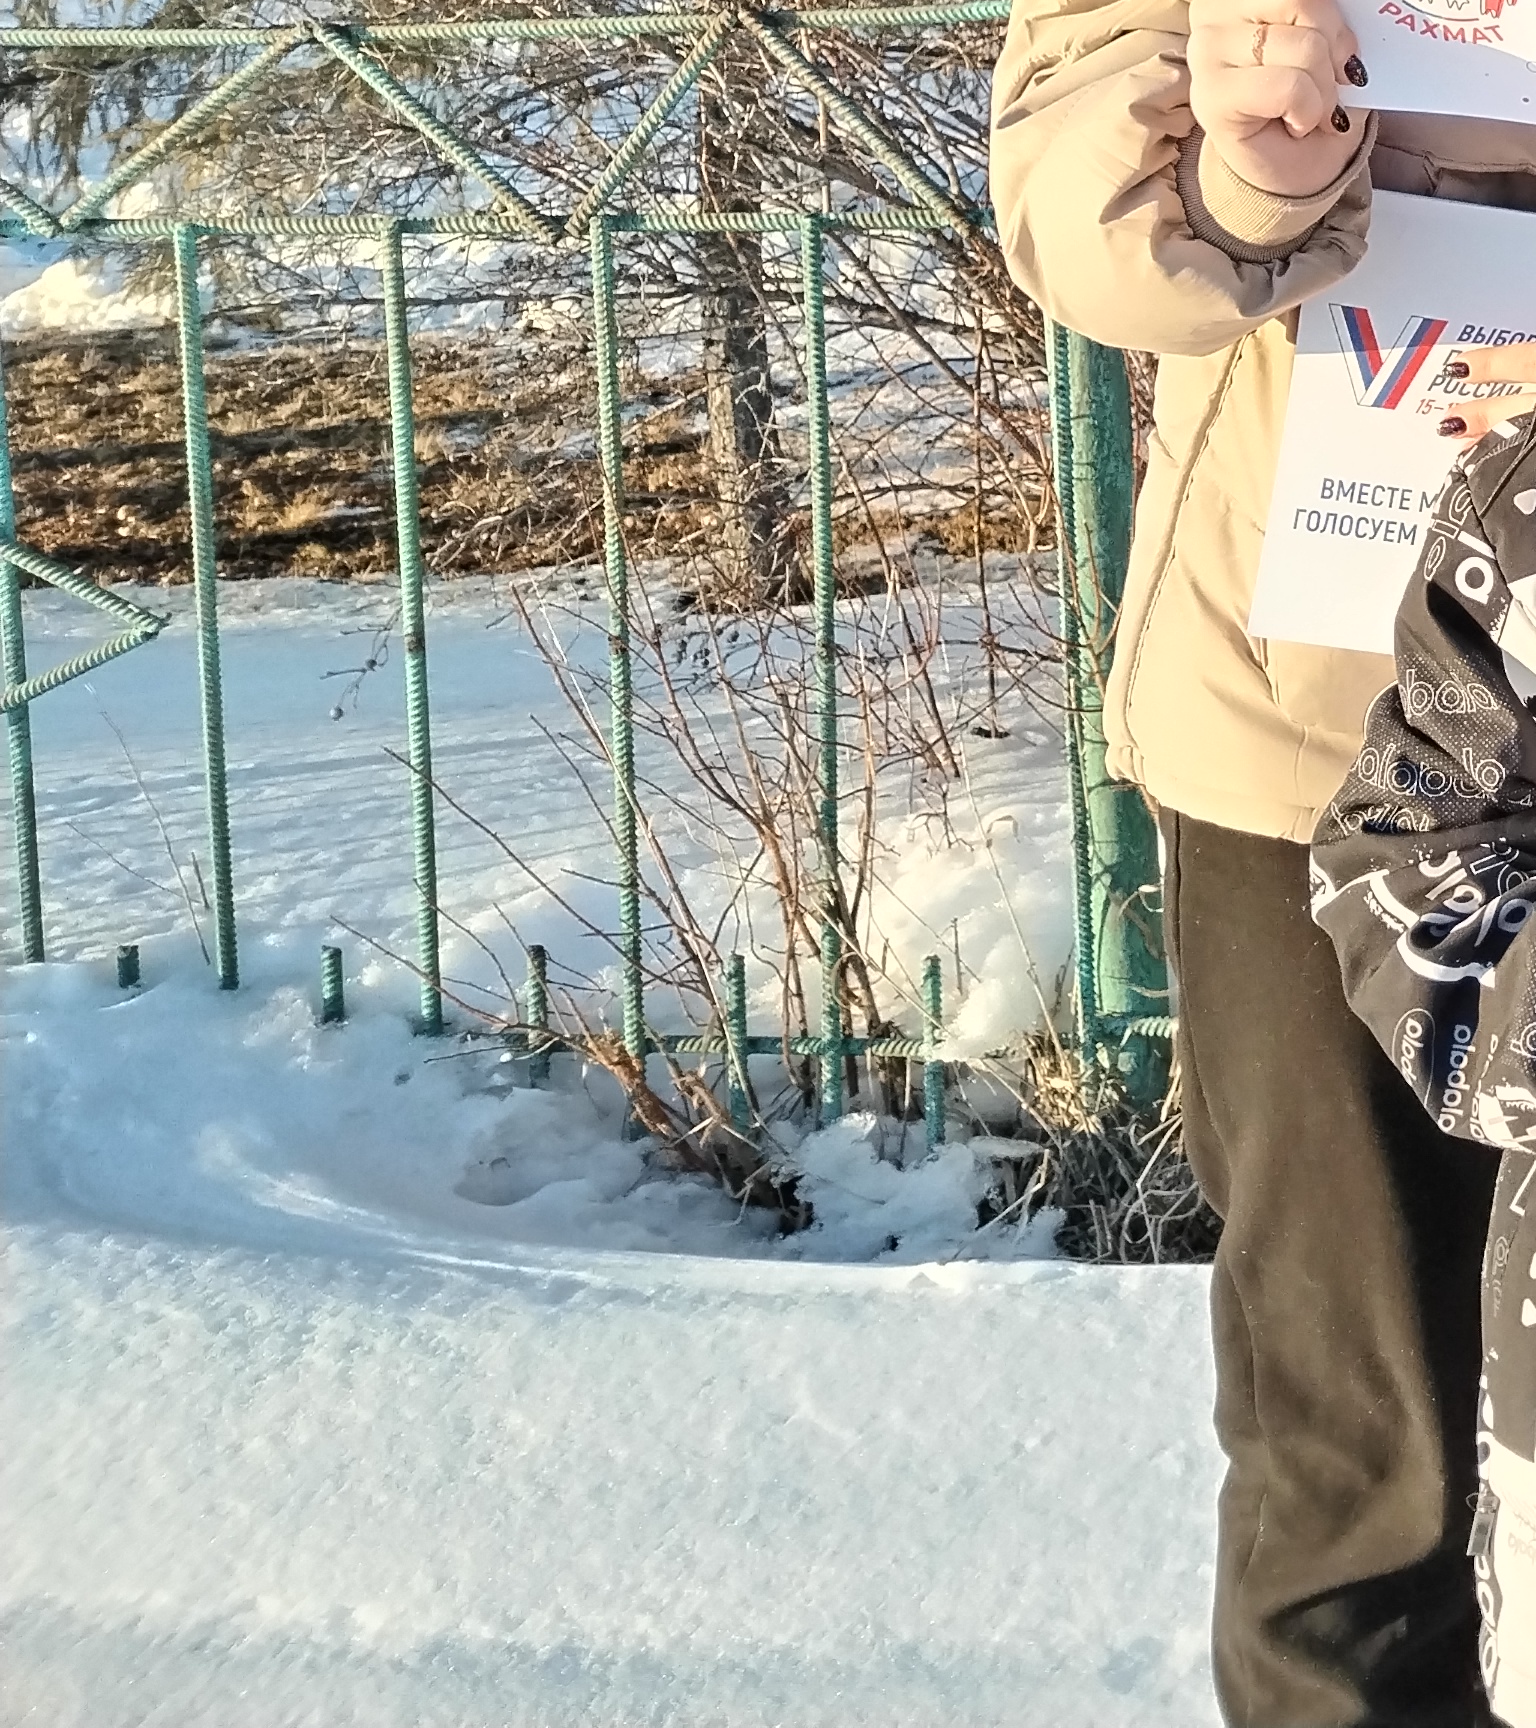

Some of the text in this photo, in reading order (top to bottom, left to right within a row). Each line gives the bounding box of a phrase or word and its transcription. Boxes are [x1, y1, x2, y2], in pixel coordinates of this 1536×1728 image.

[1377, 0, 1506, 45] РАХМАТ
[1320, 477, 1413, 511] ВМЕСТЕ
[1292, 508, 1418, 546] ГОЛОСУЕМ
